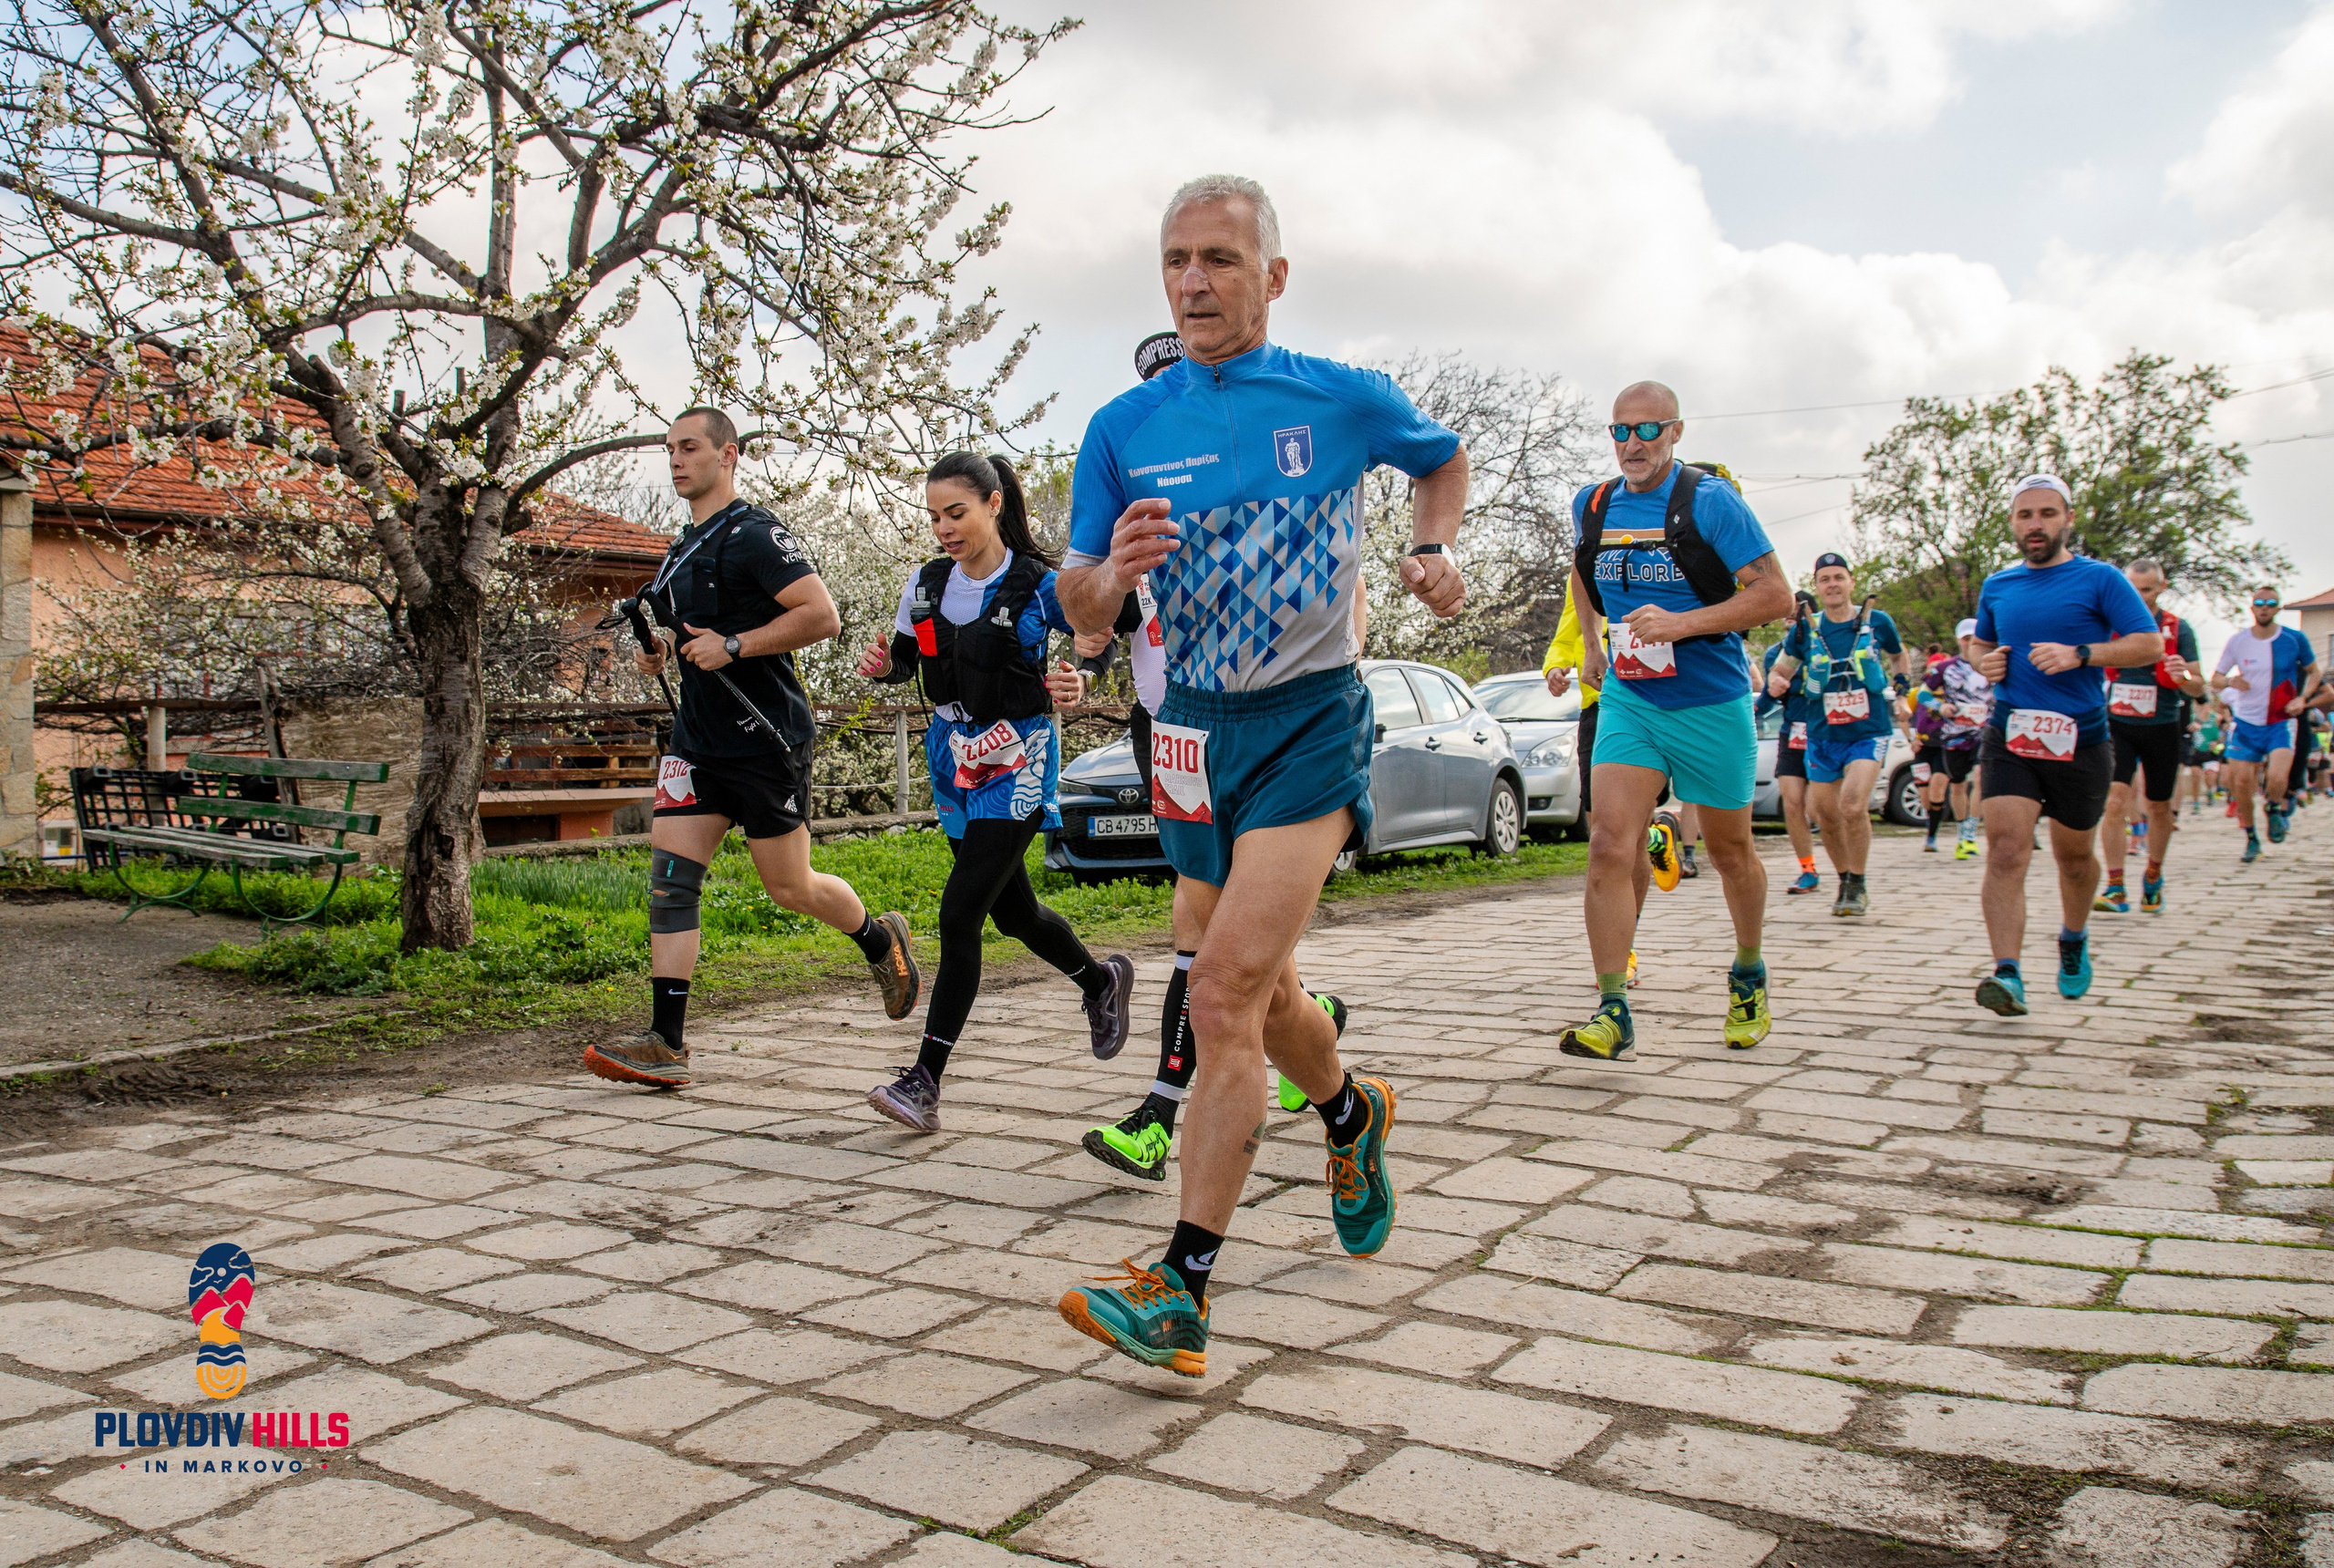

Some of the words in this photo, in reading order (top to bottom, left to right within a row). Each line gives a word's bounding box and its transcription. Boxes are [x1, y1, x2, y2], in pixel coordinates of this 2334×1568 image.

[1137, 336, 1185, 376] COMPRESS
[1128, 459, 1185, 479] Κωνσταντίνος
[1185, 453, 1220, 468] Παρίζας
[1156, 473, 1193, 488] Νάουσα
[1141, 596, 1152, 606] 22K
[1837, 693, 1864, 707] 2329
[2032, 716, 2071, 735] 2374
[961, 722, 1013, 762] 2208
[1152, 731, 1199, 774] 2310
[662, 759, 693, 780] 2312
[1164, 783, 1186, 797] TRAIL
[1097, 819, 1114, 834] CB
[1115, 817, 1146, 833] 4795
[893, 944, 909, 977] HOKA
